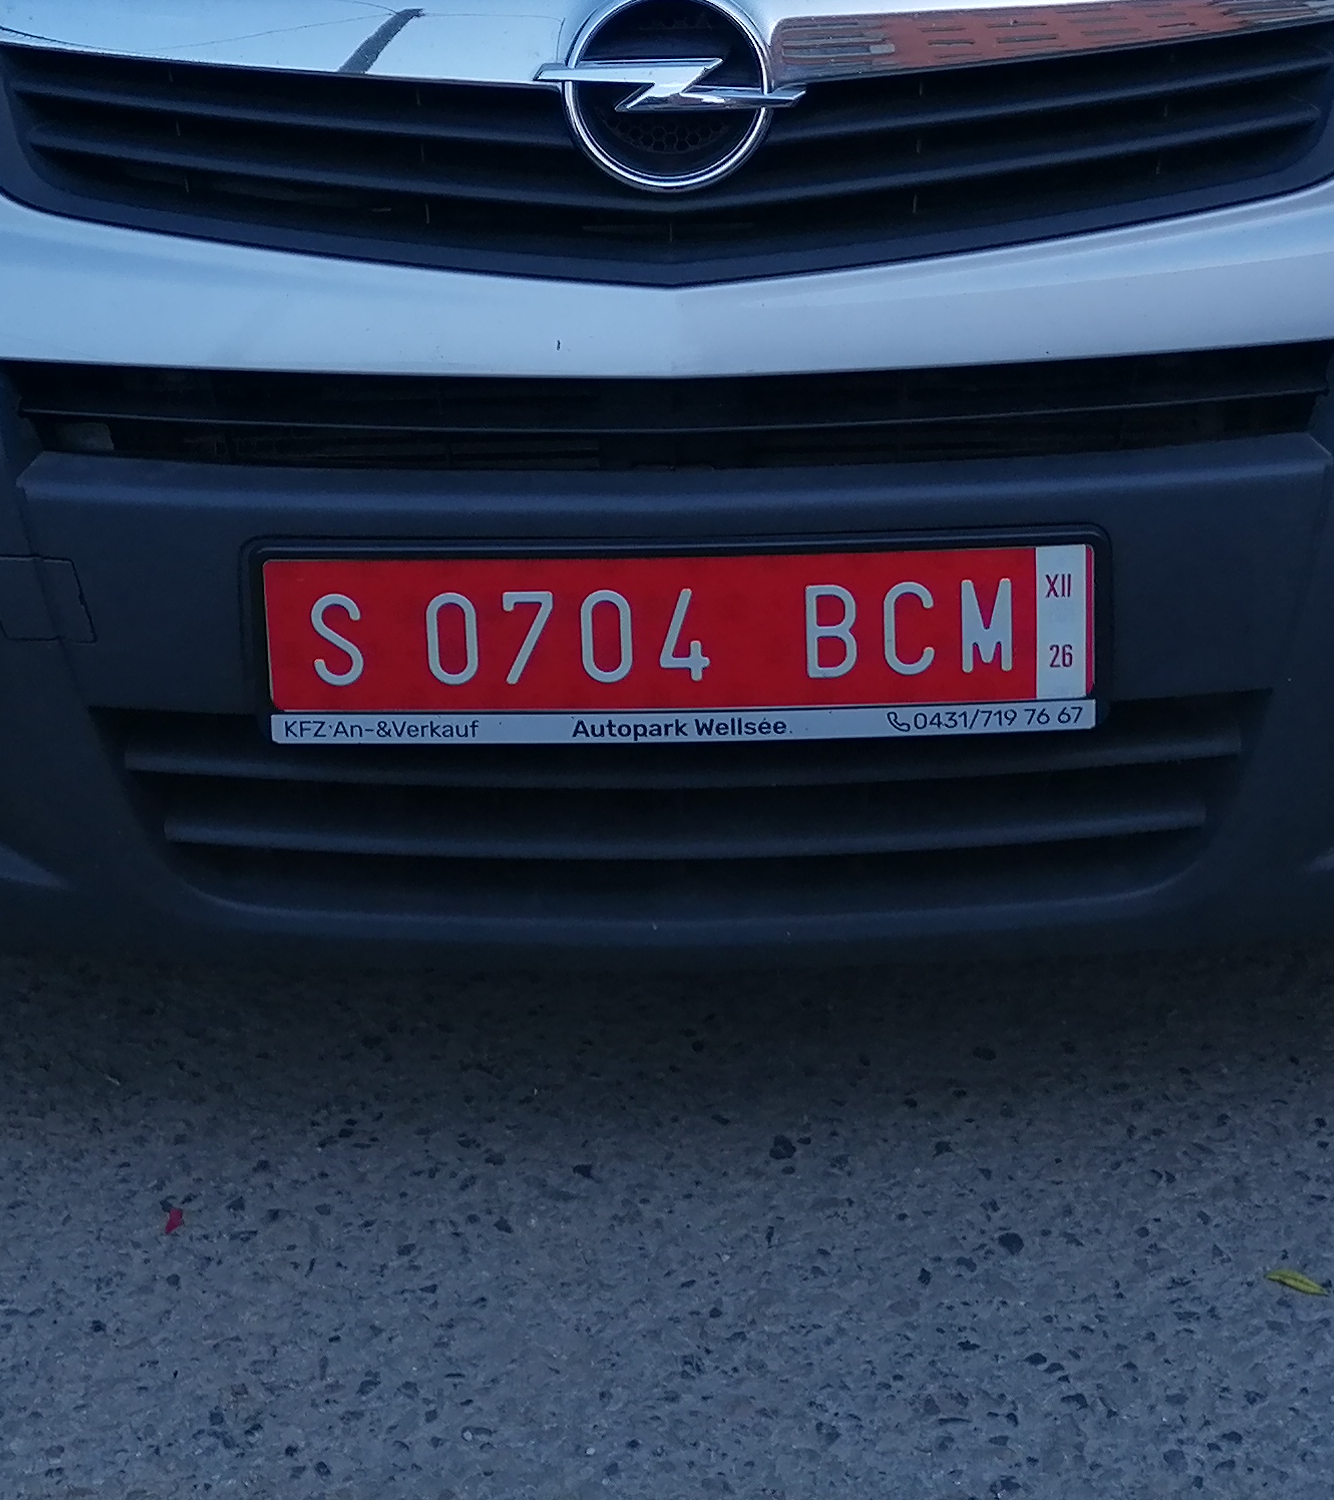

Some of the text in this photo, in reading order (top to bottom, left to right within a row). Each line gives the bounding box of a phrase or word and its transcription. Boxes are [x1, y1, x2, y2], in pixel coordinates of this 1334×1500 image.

[1045, 573, 1072, 598] XII
[309, 578, 1015, 687] S 0704 BCM
[1049, 644, 1073, 668] 26
[284, 719, 480, 739] KFZ An-&Verkauf
[571, 719, 688, 741] Autopark
[913, 706, 1083, 730] 0431/719 76 67
